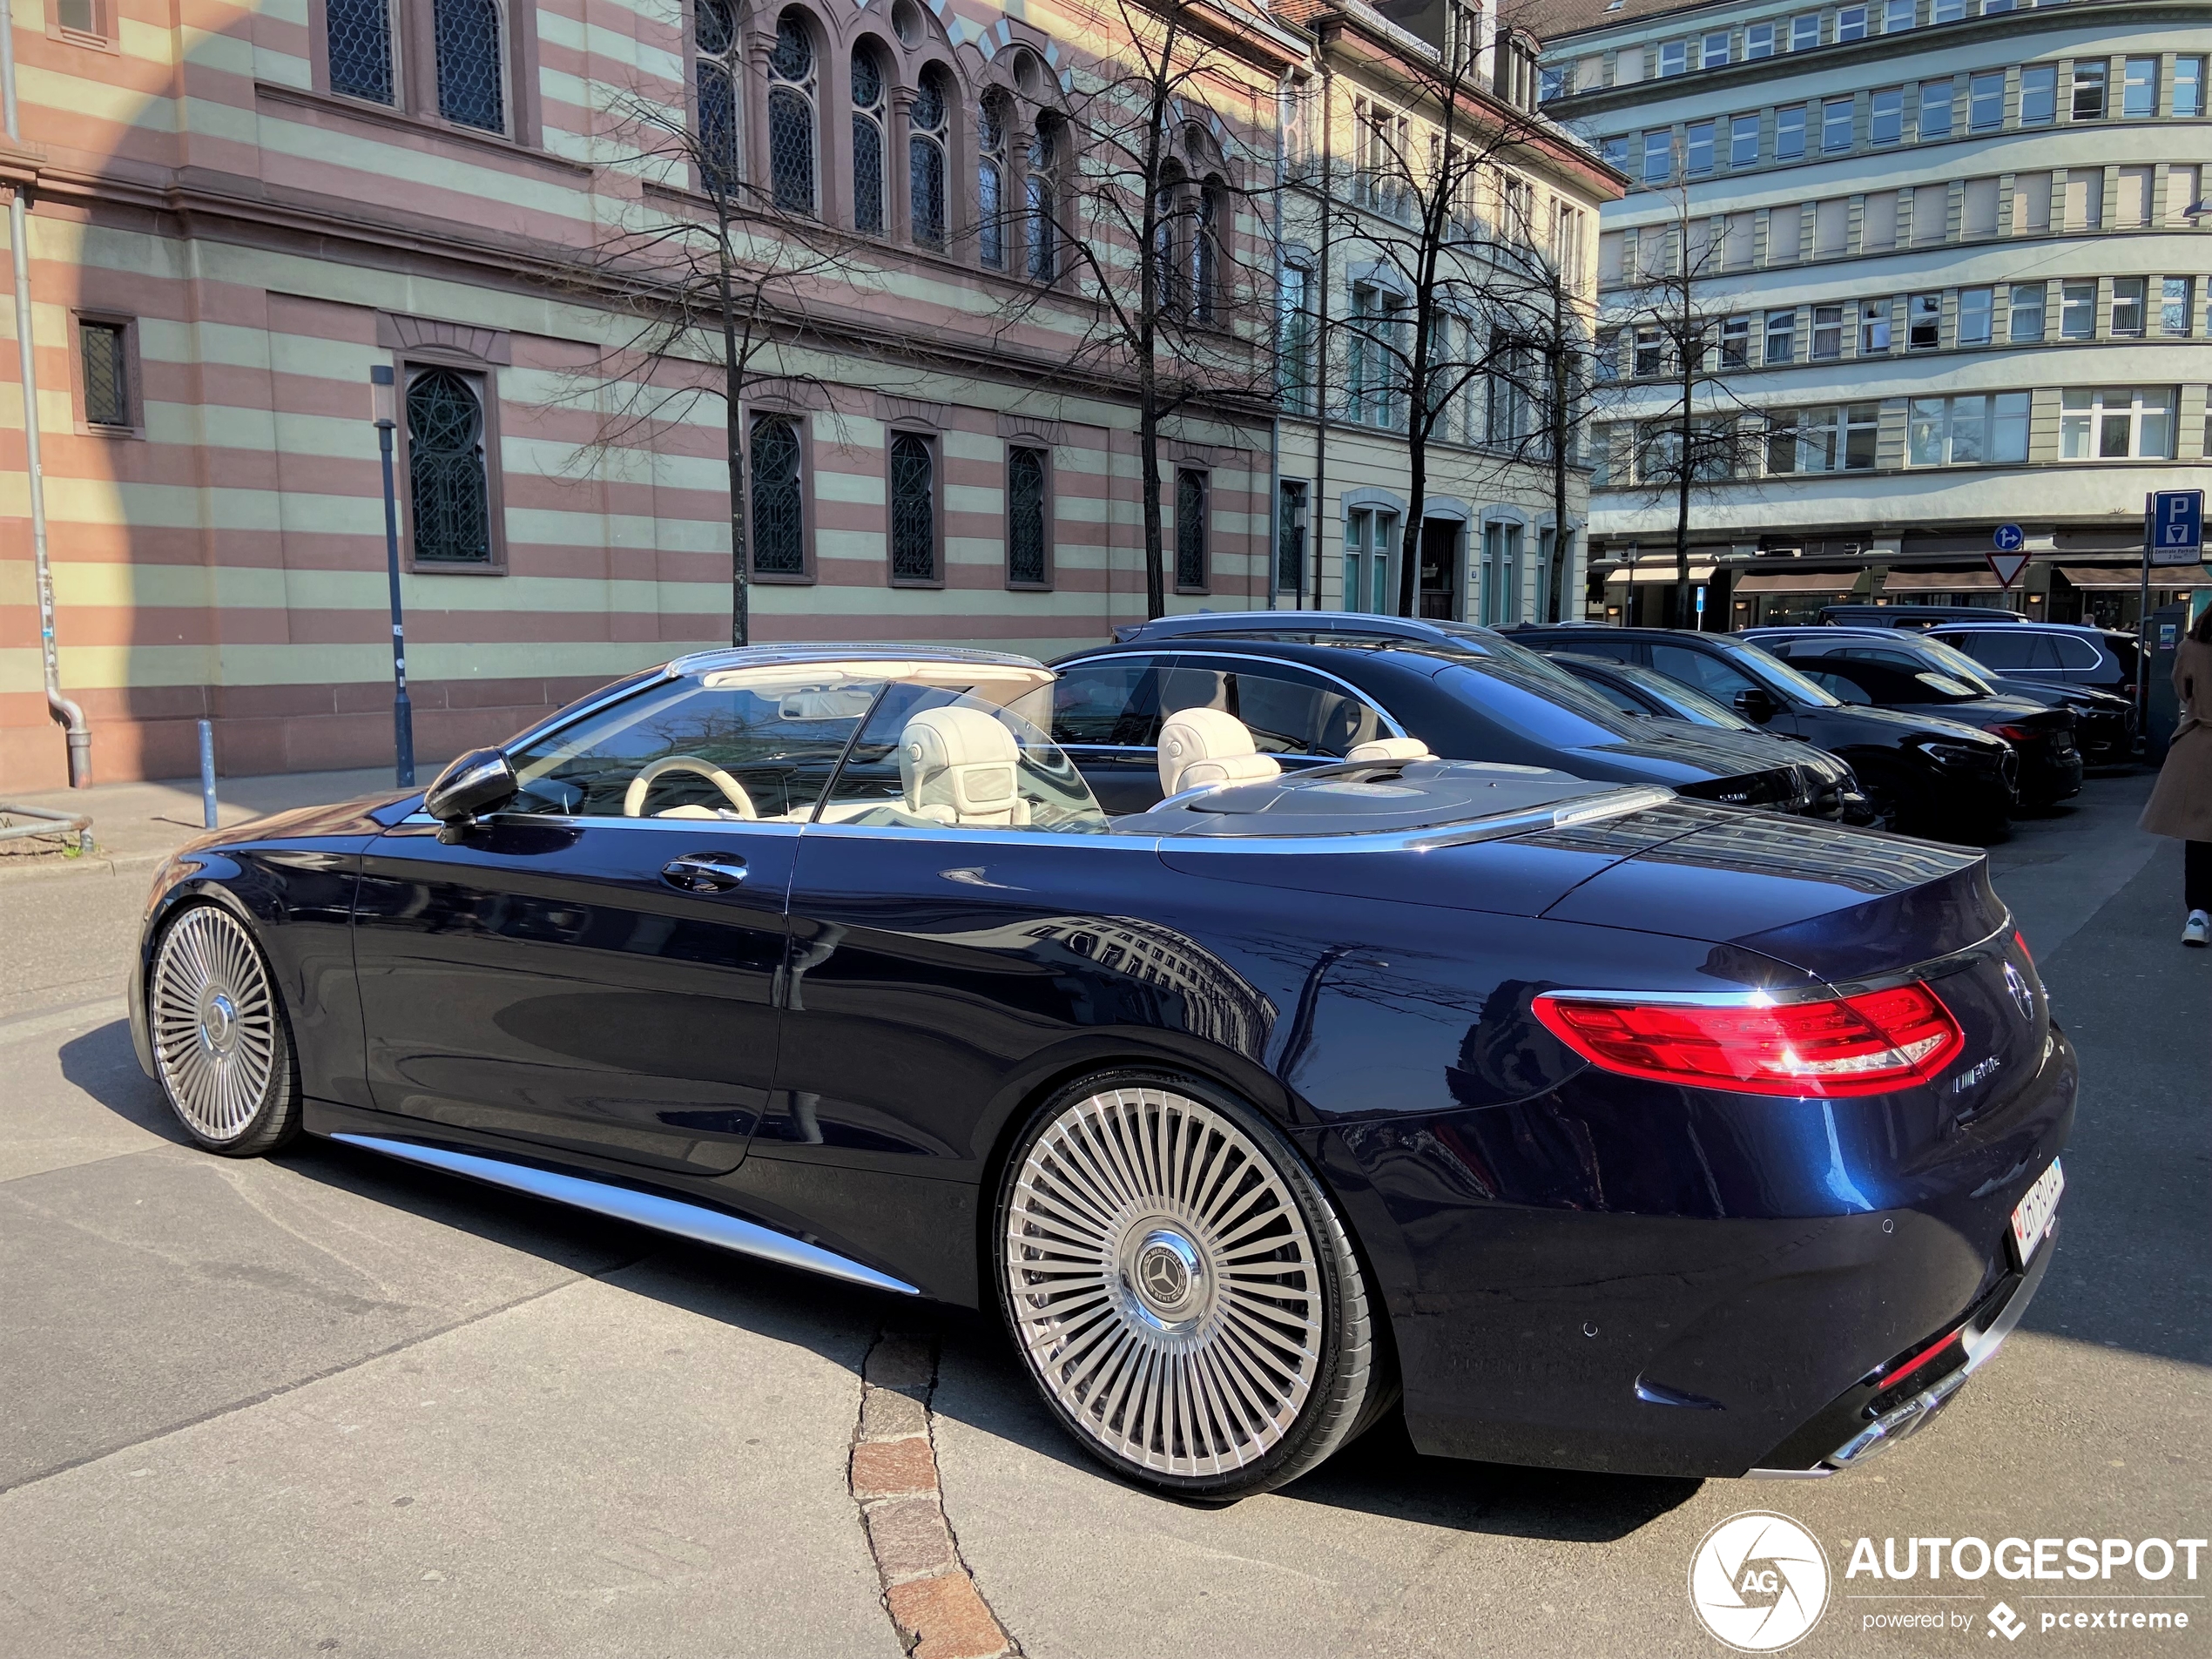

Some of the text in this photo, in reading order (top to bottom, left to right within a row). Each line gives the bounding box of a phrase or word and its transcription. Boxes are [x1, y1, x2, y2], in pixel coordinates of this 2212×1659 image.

[2169, 497, 2189, 523] P
[1150, 1248, 1180, 1264] MERCEDES
[1154, 1291, 1171, 1301] BENZ
